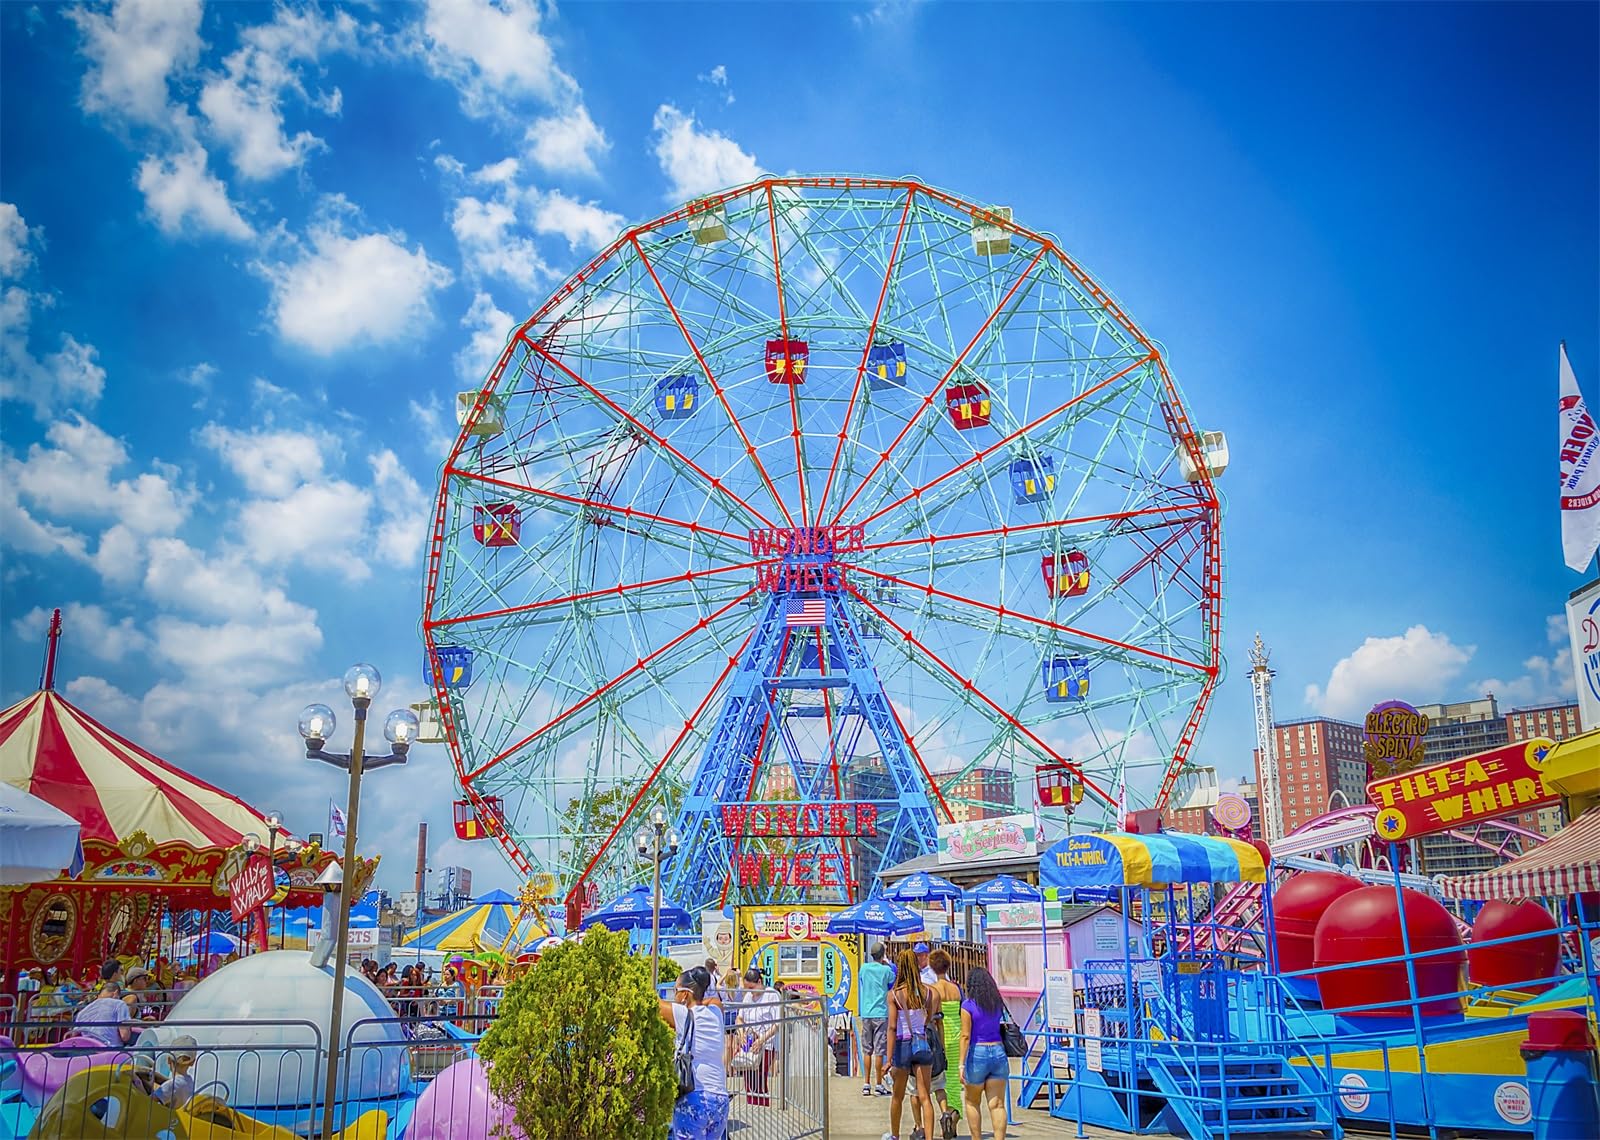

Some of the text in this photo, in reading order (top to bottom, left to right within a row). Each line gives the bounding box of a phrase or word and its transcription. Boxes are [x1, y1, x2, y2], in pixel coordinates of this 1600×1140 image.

[748, 525, 865, 557] WONDER
[757, 562, 857, 593] WHEEL
[1365, 711, 1430, 736] ELECTRO
[1376, 736, 1413, 761] SPIN
[1375, 759, 1499, 807] TILT-A-
[721, 803, 878, 836] WONDER
[953, 831, 1019, 854] Sea Serpent
[738, 853, 860, 886] WHEEL
[1055, 850, 1108, 867] TILT-A-WHIRL
[231, 862, 260, 896] WILLY
[233, 875, 270, 915] WHALE
[825, 951, 833, 989] GAMES
[1503, 1098, 1526, 1106] WONDER
[1507, 1104, 1524, 1112] WHEEL
